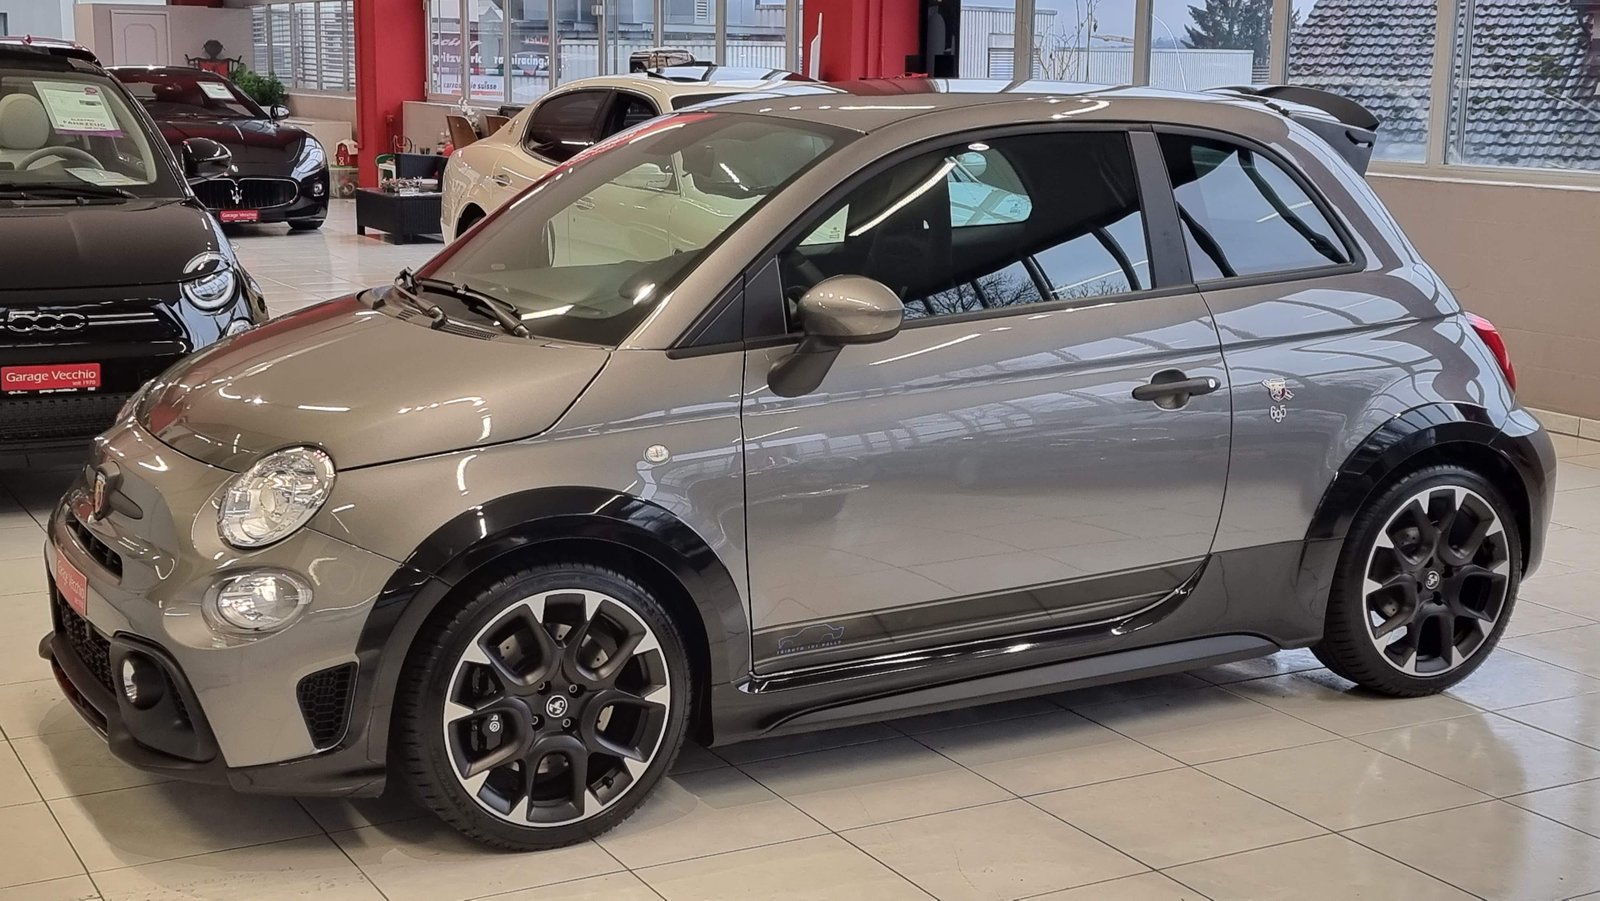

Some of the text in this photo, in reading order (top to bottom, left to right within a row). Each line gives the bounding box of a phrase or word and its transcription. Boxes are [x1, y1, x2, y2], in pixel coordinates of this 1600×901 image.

[477, 81, 497, 90] suisse
[7, 310, 86, 332] 500
[6, 369, 97, 384] Garage Vecchio
